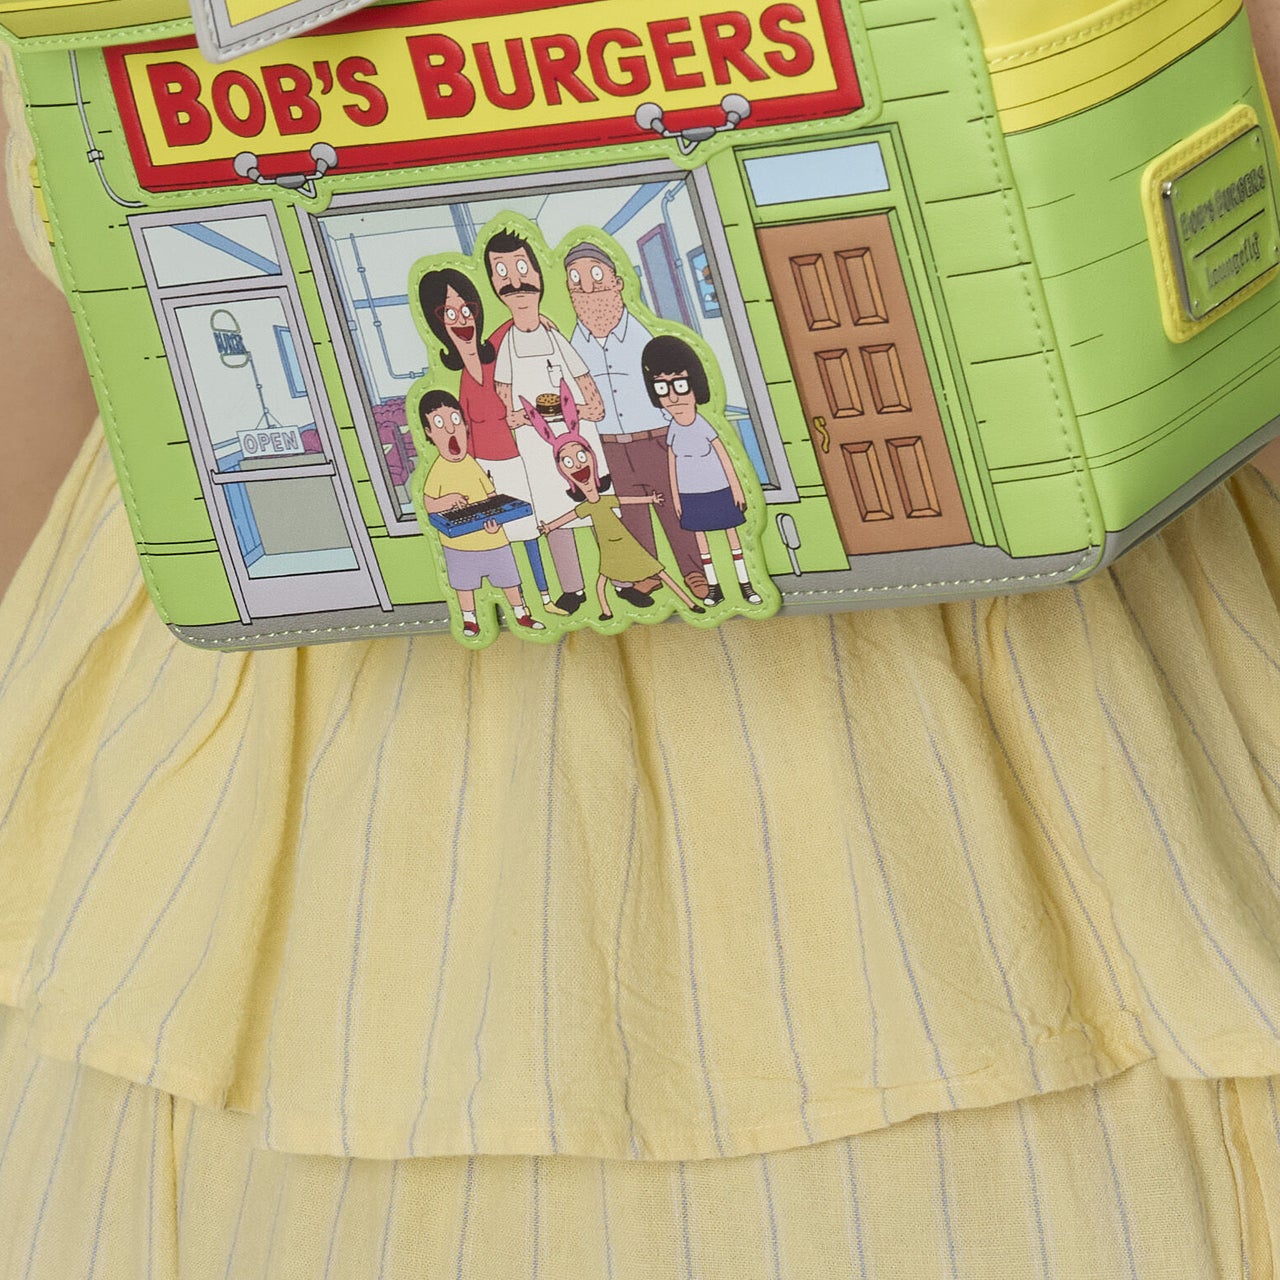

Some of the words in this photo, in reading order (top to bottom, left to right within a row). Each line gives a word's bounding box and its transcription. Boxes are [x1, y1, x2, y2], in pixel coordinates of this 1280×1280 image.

[147, 56, 389, 147] BOB'S
[406, 2, 814, 121] BURGERS
[243, 431, 299, 454] OPEN
